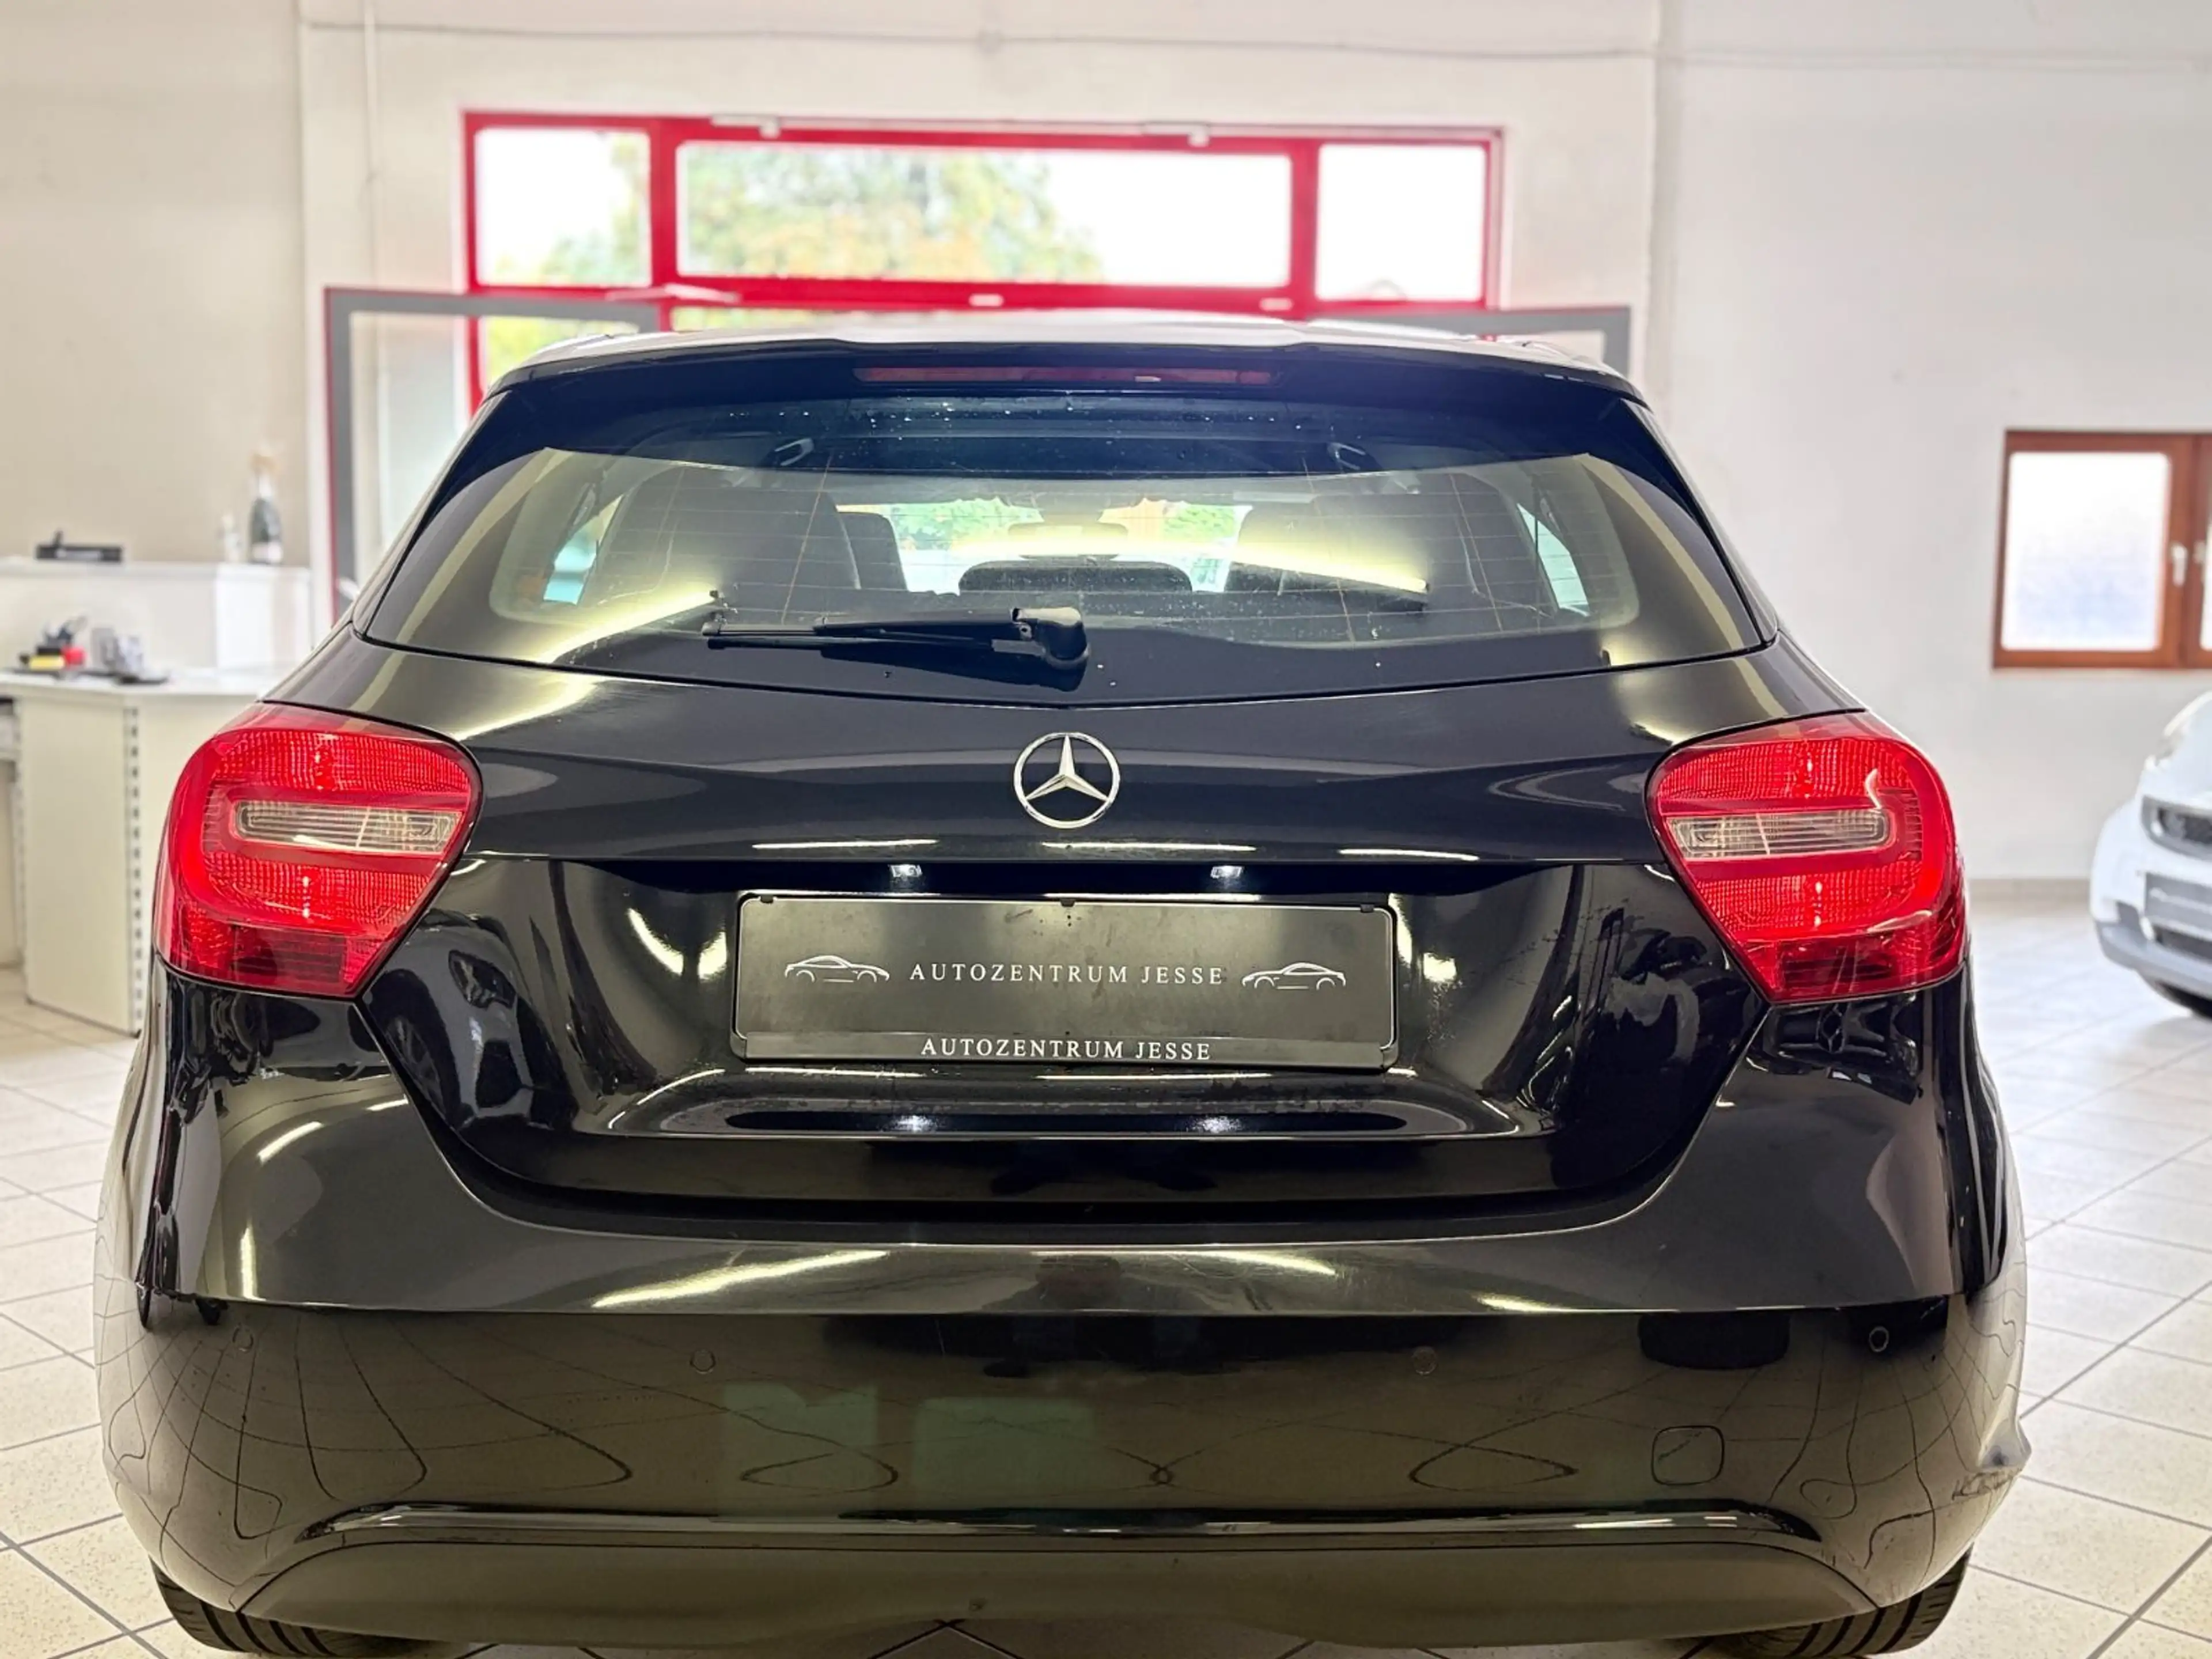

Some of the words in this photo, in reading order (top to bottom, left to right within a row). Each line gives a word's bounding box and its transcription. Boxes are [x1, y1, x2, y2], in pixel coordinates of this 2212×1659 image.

[910, 963, 1127, 983] AUTOZENTRUM
[1141, 966, 1222, 984] JESSE
[921, 1038, 1123, 1059] AUTOZENTRUM
[1135, 1041, 1211, 1061] JESSE
